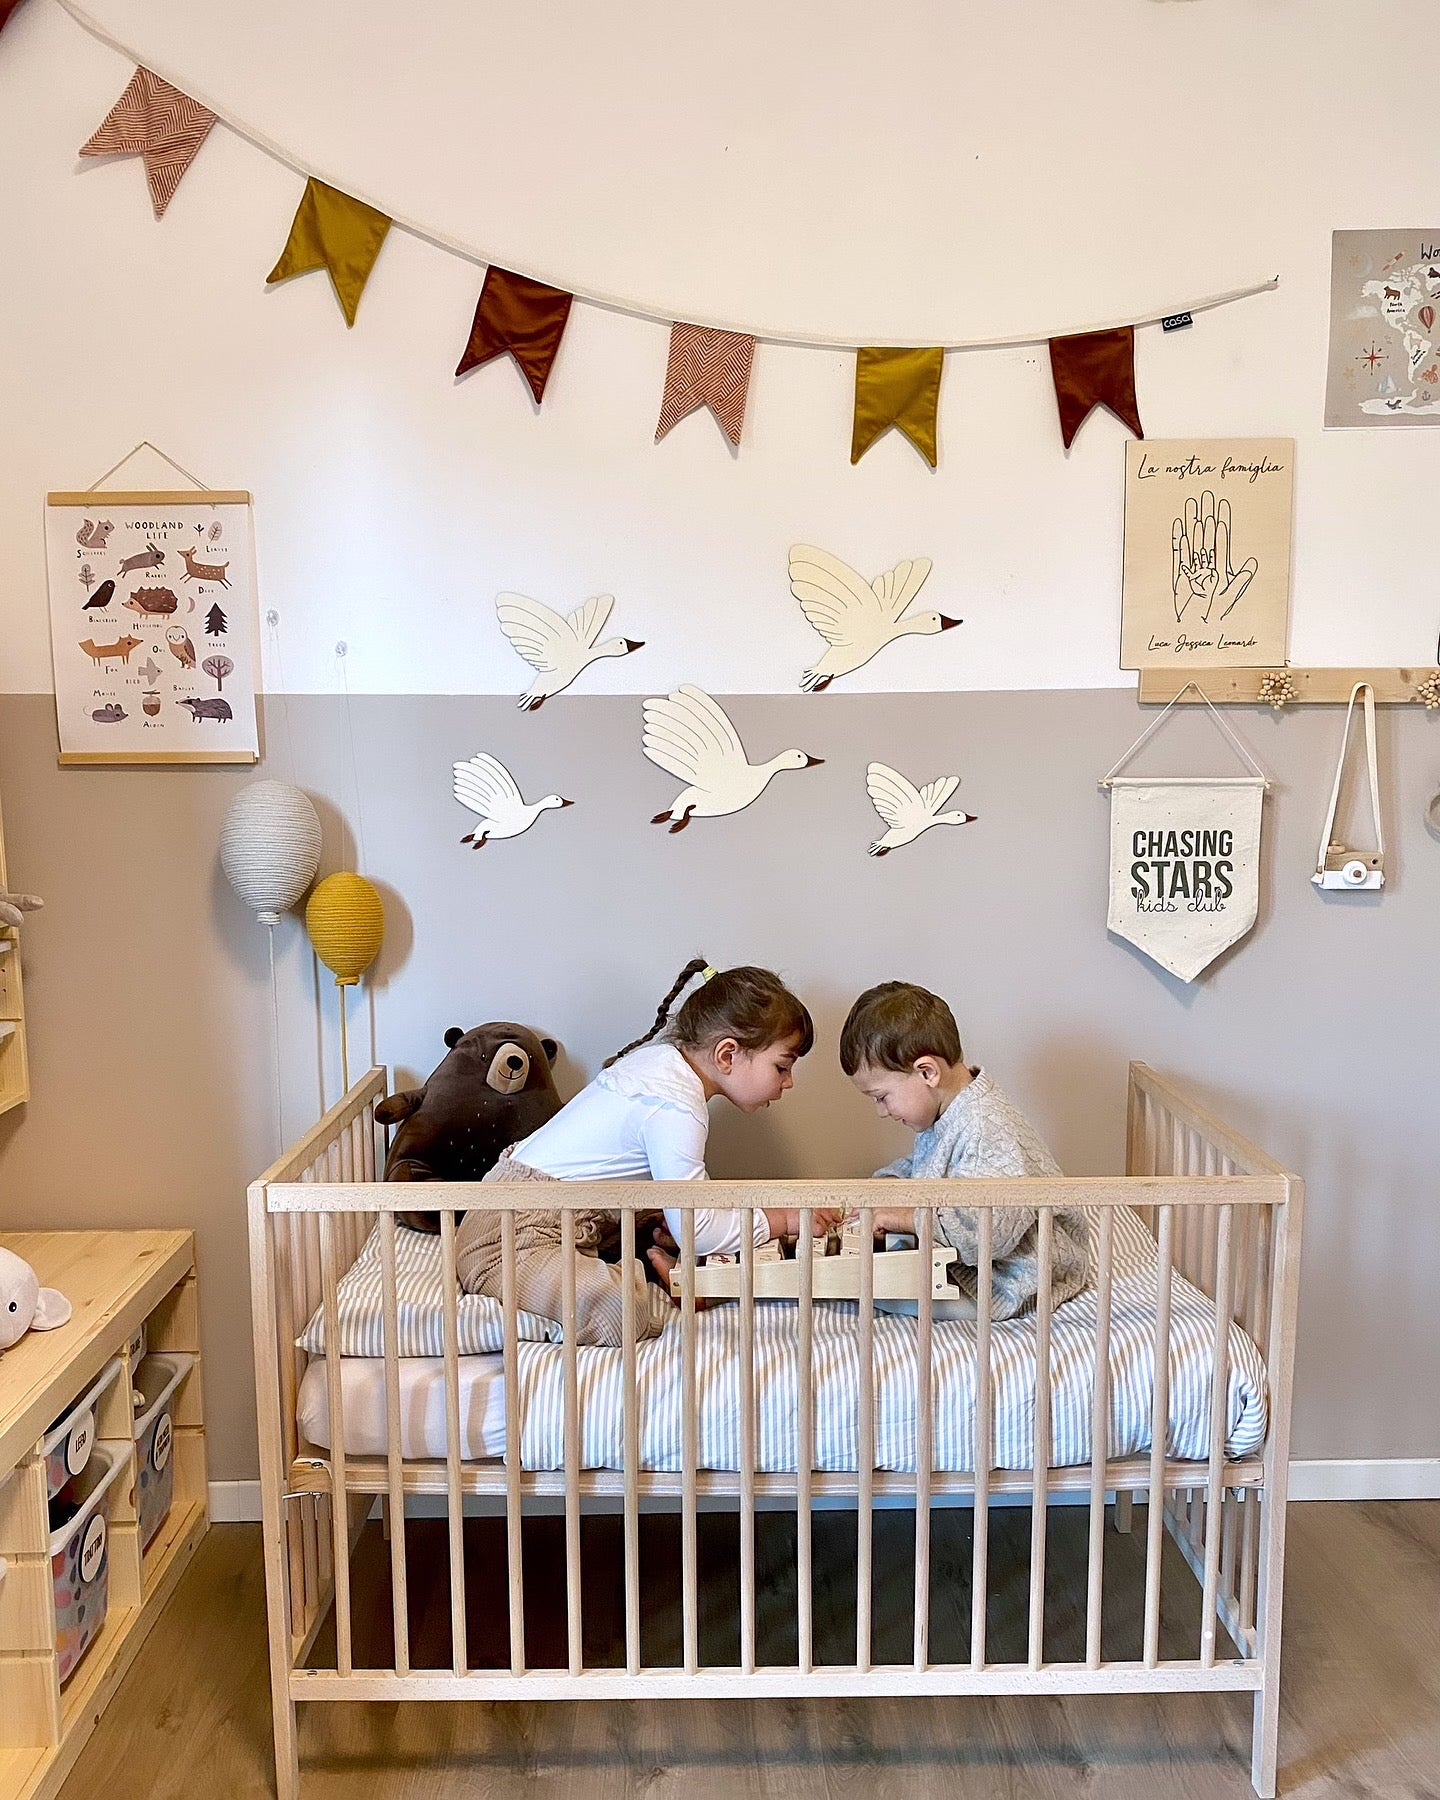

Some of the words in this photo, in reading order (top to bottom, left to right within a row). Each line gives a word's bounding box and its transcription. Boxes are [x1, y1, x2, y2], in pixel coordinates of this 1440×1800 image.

[1420, 242, 1440, 260] Wo
[1163, 315, 1190, 328] casa
[1138, 453, 1160, 480] La
[1165, 454, 1217, 480] nostra
[1221, 455, 1285, 484] famiglia
[125, 521, 184, 530] WOODLAND
[1148, 634, 1172, 651] Luca
[1174, 633, 1214, 653] Jessica
[1217, 633, 1258, 650] Leonardo
[1132, 830, 1233, 858] CHASING
[1130, 861, 1234, 899] STARS
[1136, 888, 1179, 912] kids
[1187, 888, 1227, 912] club
